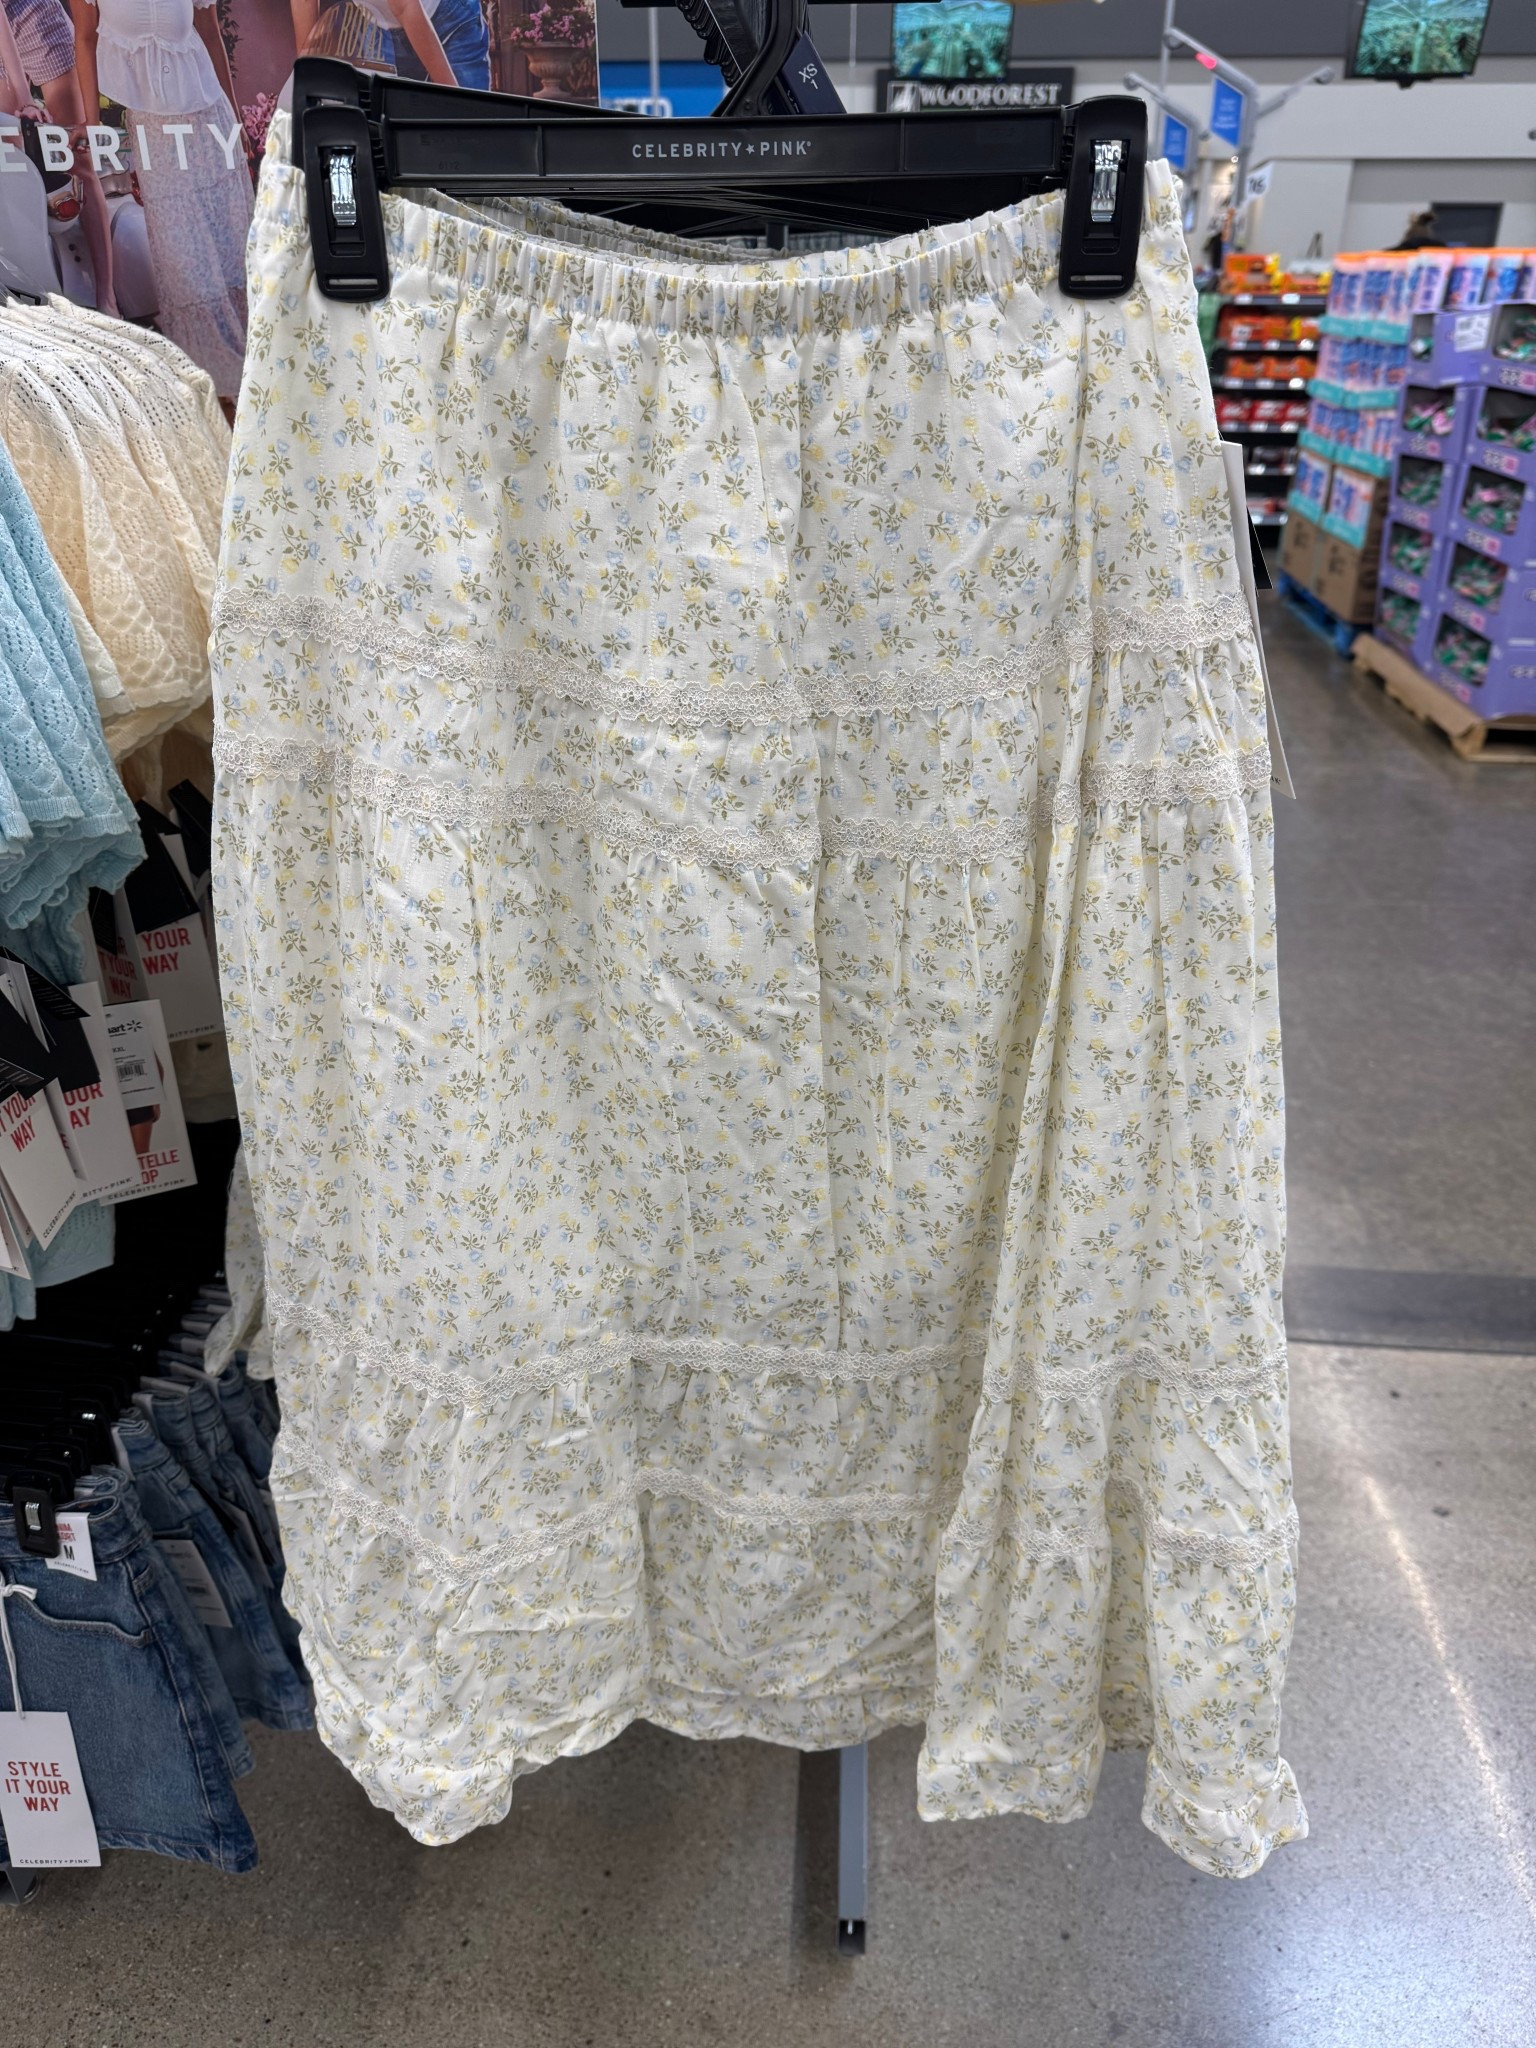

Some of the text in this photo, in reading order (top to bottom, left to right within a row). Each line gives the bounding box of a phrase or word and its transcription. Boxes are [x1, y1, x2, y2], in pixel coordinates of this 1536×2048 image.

[798, 63, 818, 83] XS
[919, 82, 1061, 106] WOODFOREST
[632, 142, 742, 158] CELEBRITY
[141, 927, 191, 952] YOUR
[142, 952, 179, 976] WAY
[10, 1115, 36, 1153] WAY
[64, 1545, 75, 1560] M
[8, 1761, 61, 1777] STYLE
[5, 1779, 71, 1795] IT YOUR
[23, 1797, 59, 1811] WAY
